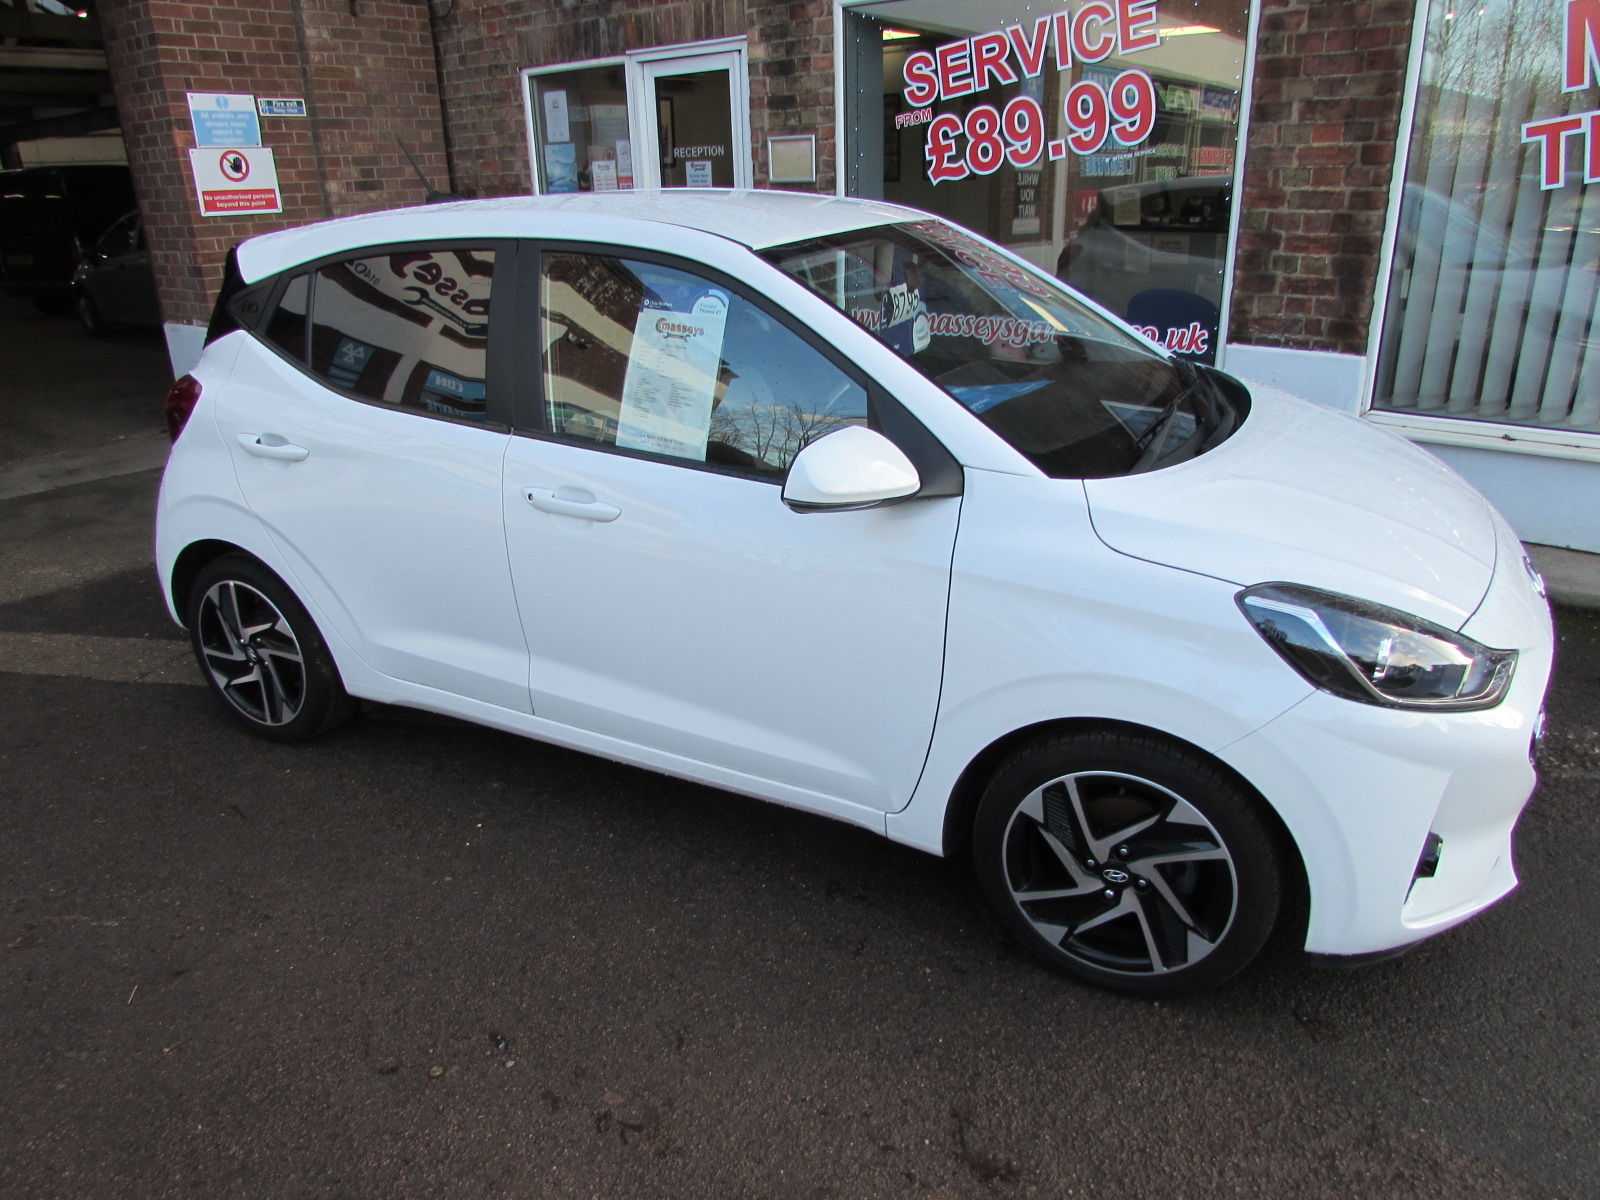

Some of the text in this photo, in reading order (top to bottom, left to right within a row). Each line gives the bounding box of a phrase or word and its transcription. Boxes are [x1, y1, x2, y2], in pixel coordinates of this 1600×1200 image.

[903, 0, 1161, 107] SERVICE
[895, 107, 933, 130] FROM
[925, 69, 1157, 186] £89.99
[673, 145, 725, 158] RECEPTION
[213, 193, 252, 201] unauthorised
